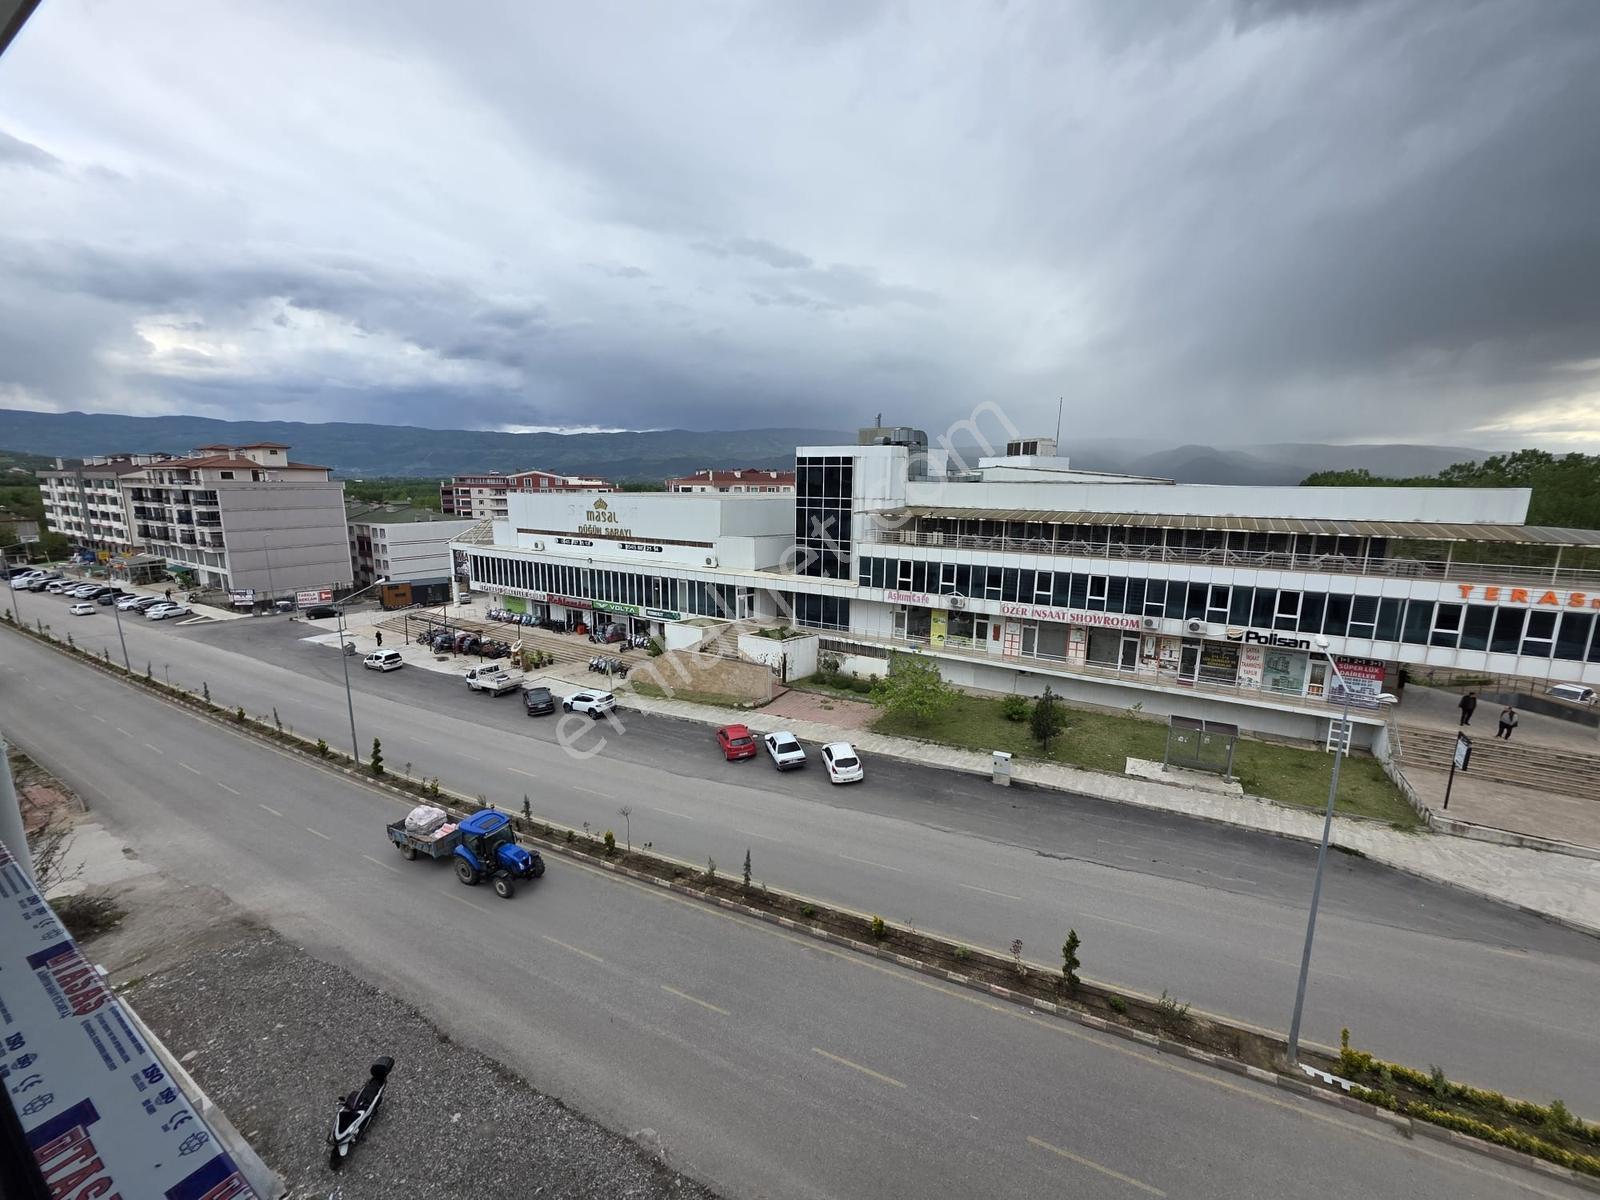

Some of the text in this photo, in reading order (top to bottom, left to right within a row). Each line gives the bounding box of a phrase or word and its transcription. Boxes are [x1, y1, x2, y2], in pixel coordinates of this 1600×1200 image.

[1458, 584, 1586, 607] TERAS
[609, 604, 635, 613] VOLTA
[1002, 603, 1027, 616] ÖZER
[1069, 613, 1140, 628] SHOWROOM
[1245, 631, 1310, 650] Polisan
